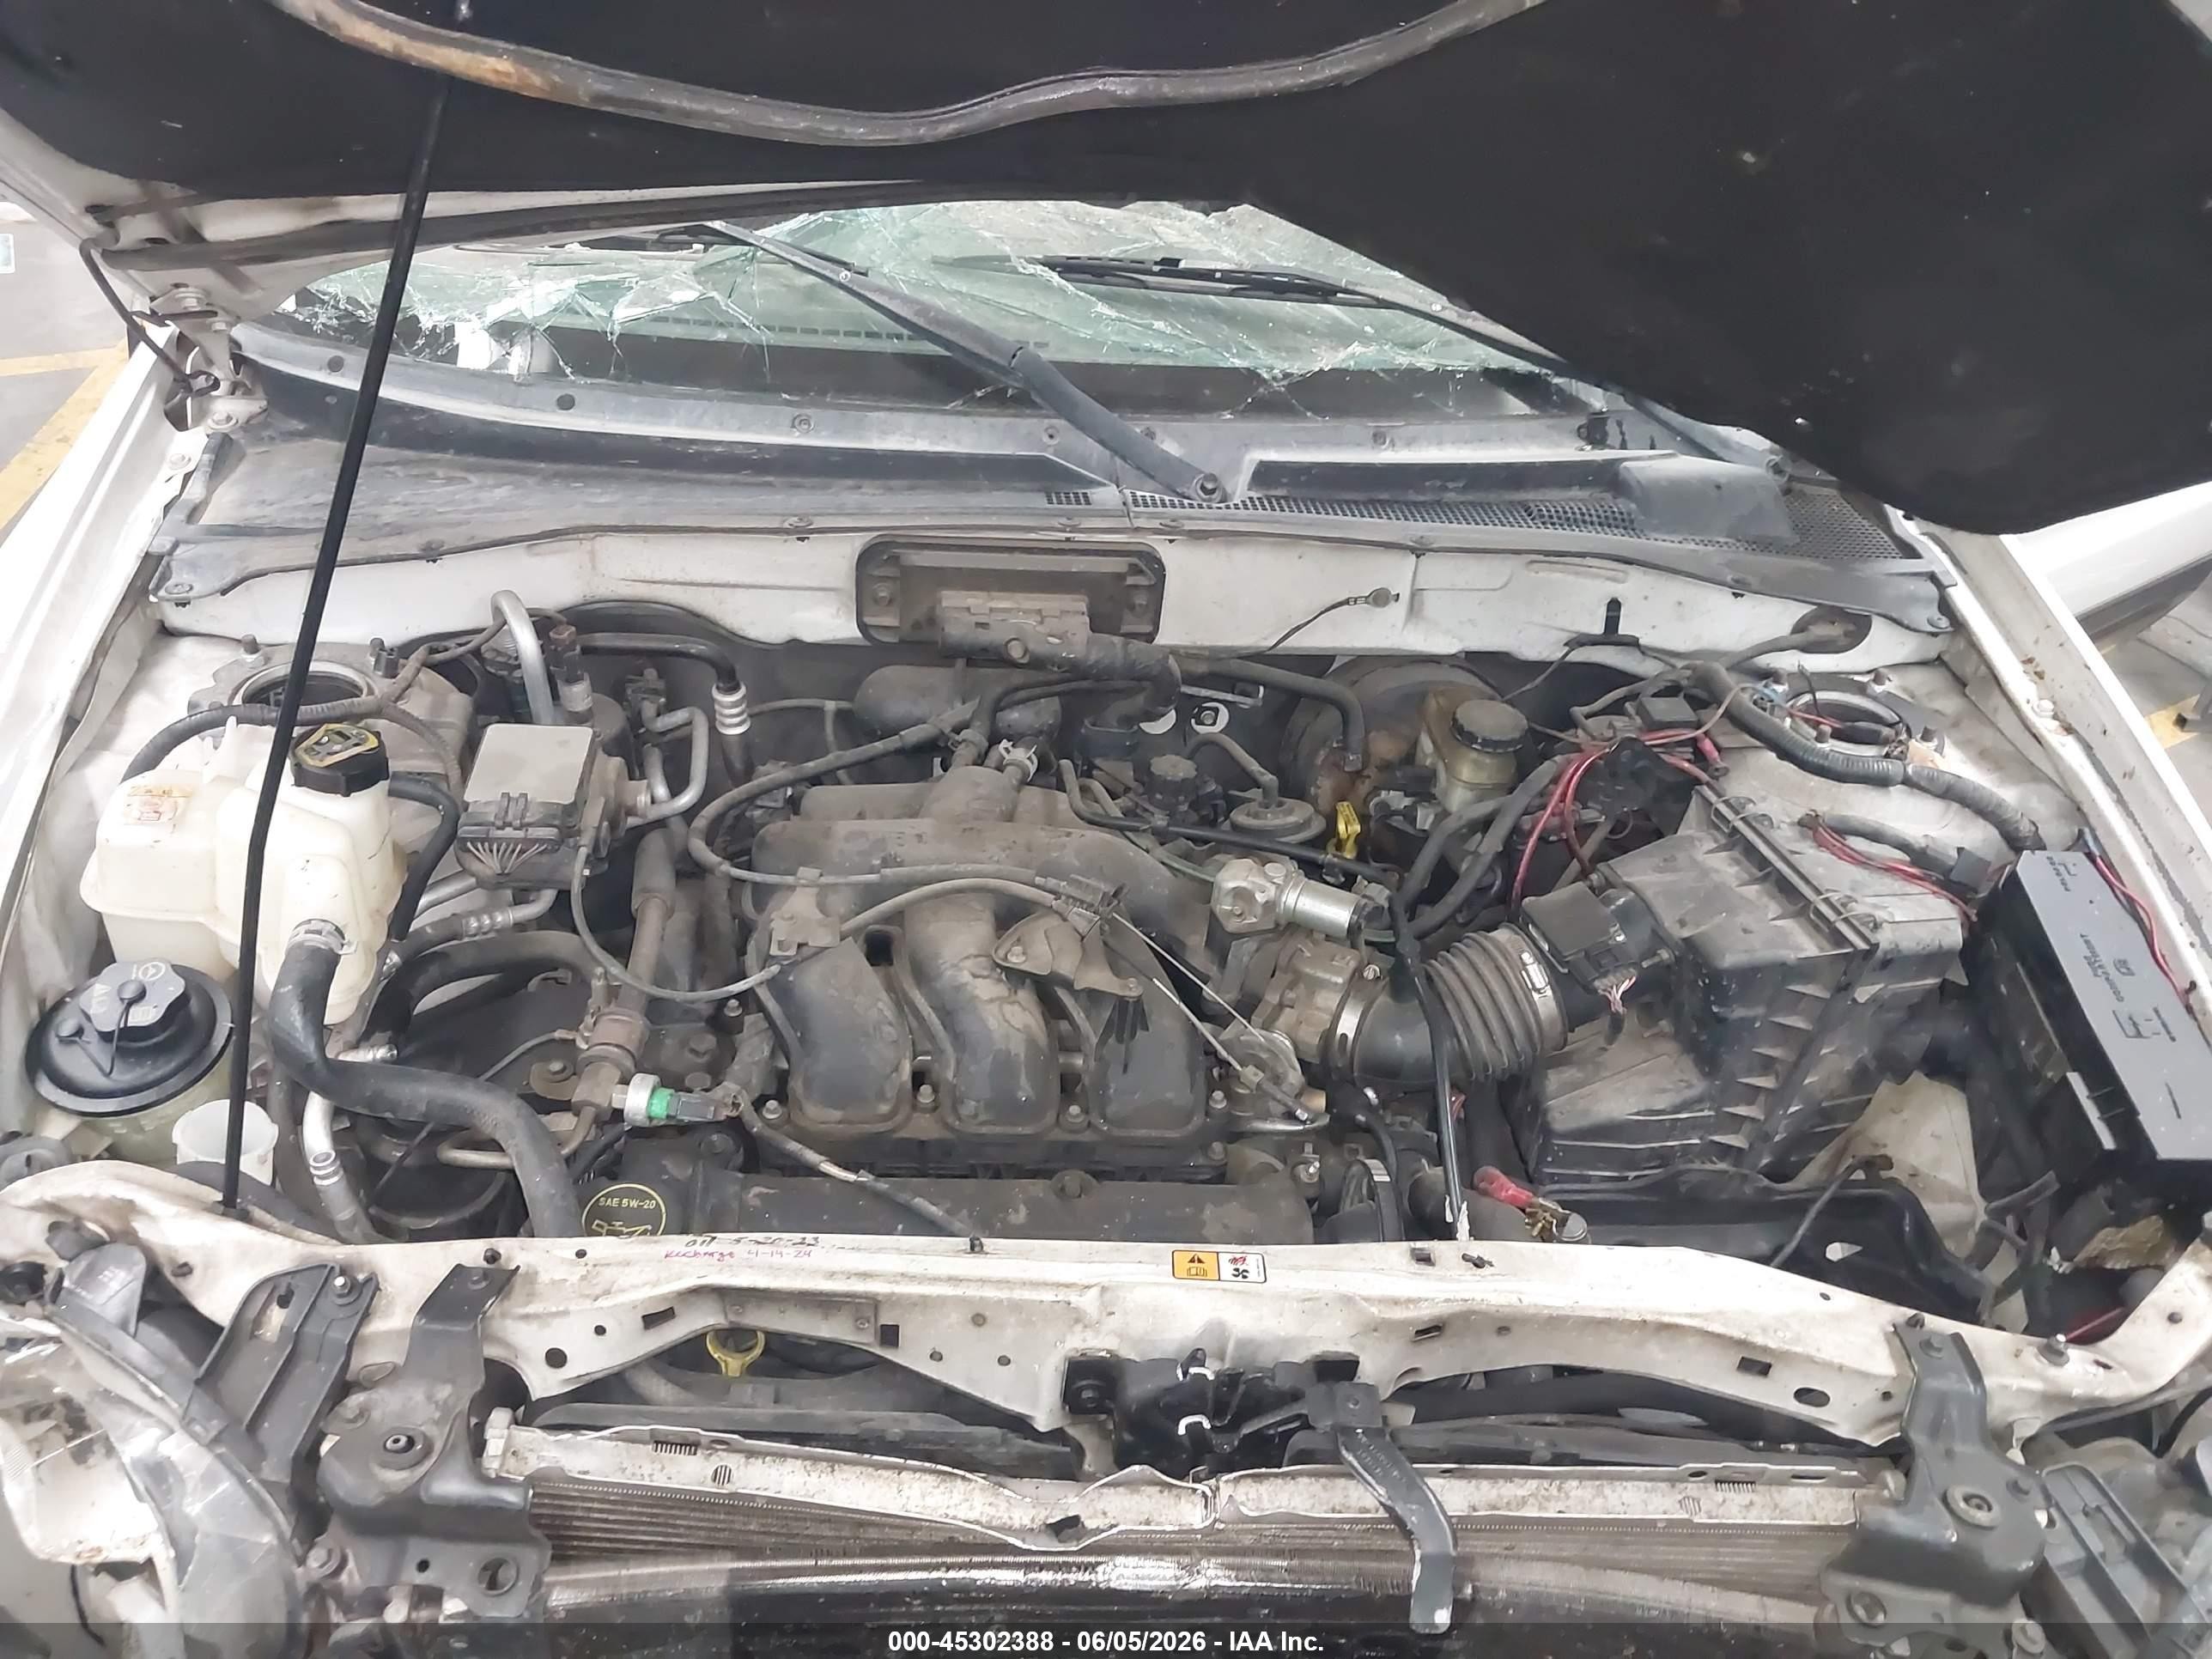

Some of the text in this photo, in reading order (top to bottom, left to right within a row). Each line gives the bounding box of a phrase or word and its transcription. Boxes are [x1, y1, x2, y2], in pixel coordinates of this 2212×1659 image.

[599, 1196, 656, 1209] SAE 5W-20
[748, 1249, 812, 1258] 4-14-24
